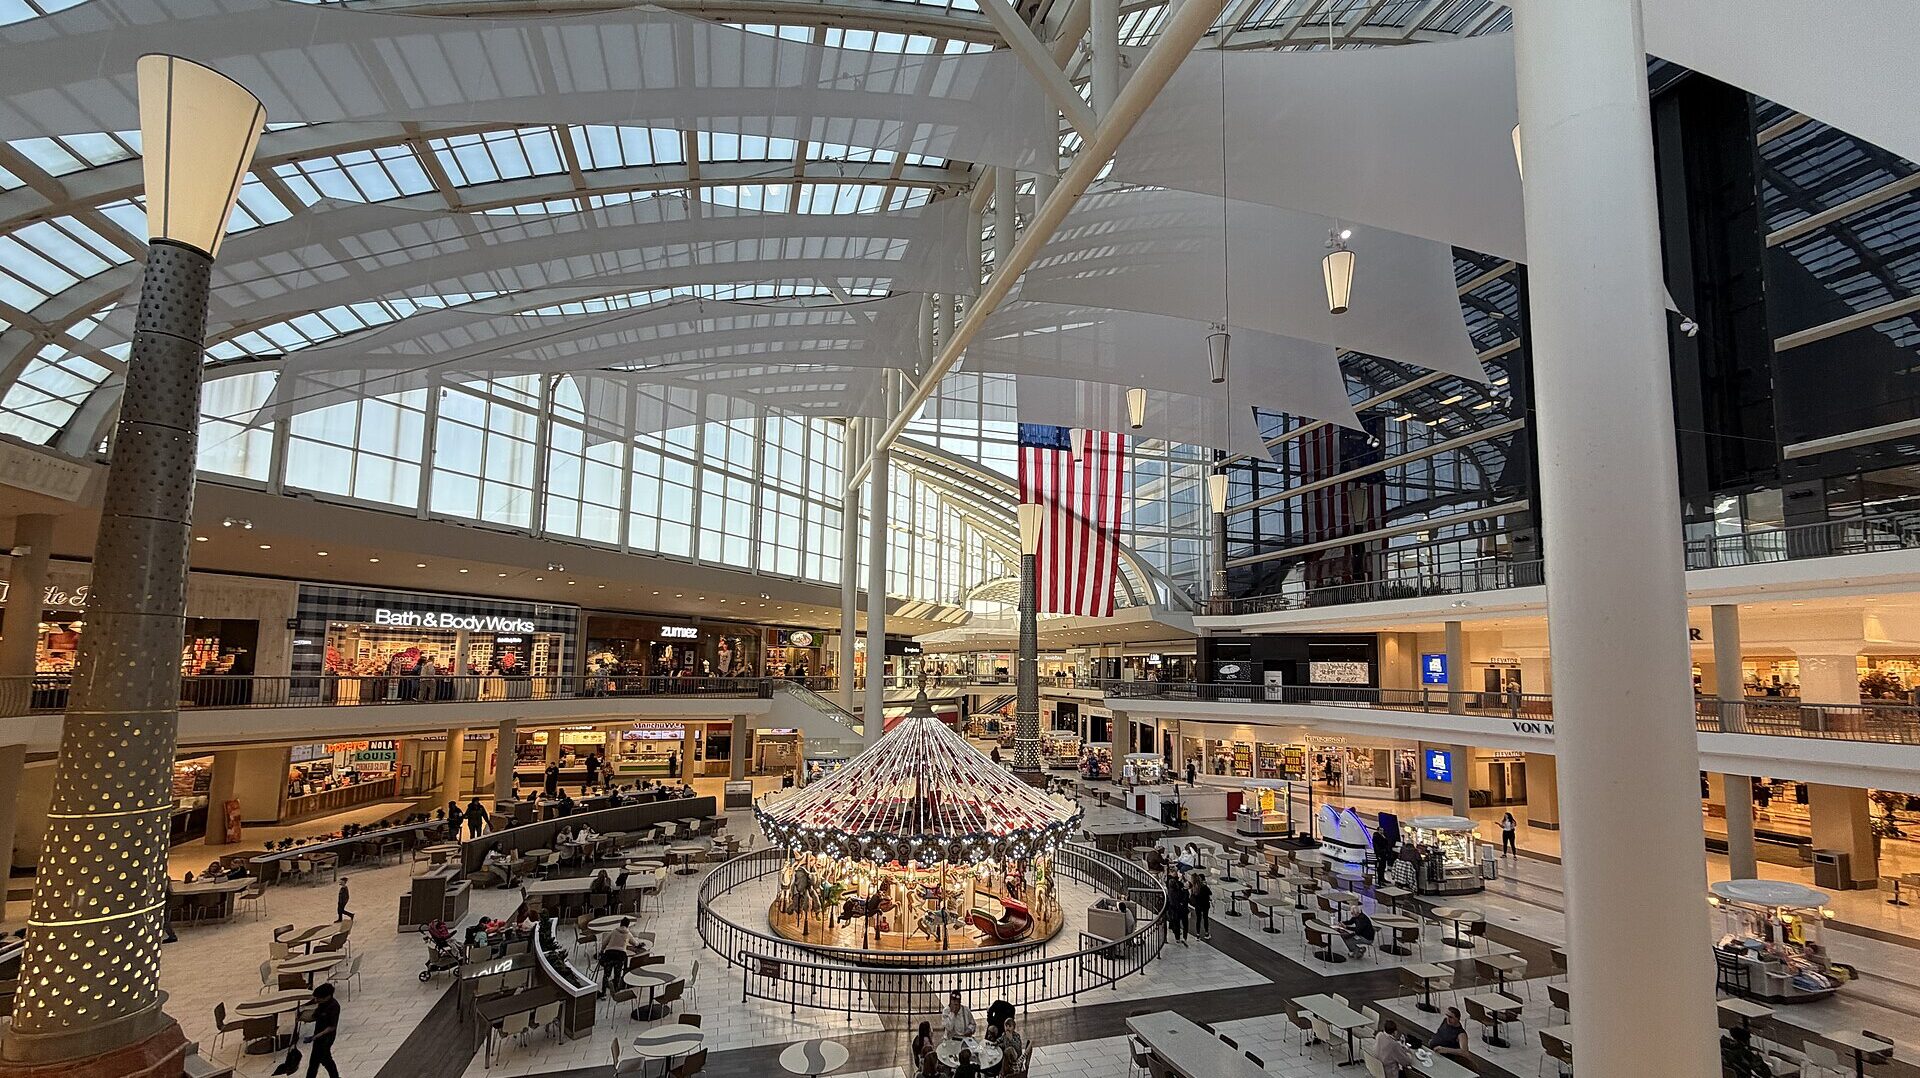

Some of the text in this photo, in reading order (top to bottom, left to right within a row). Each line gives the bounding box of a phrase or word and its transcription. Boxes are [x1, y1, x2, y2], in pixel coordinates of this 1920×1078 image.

[375, 608, 535, 632] Bath & Body Works
[661, 626, 698, 639] zumiez
[1513, 721, 1541, 734] VON
[370, 741, 393, 749] NOLA
[1234, 761, 1249, 769] SALE
